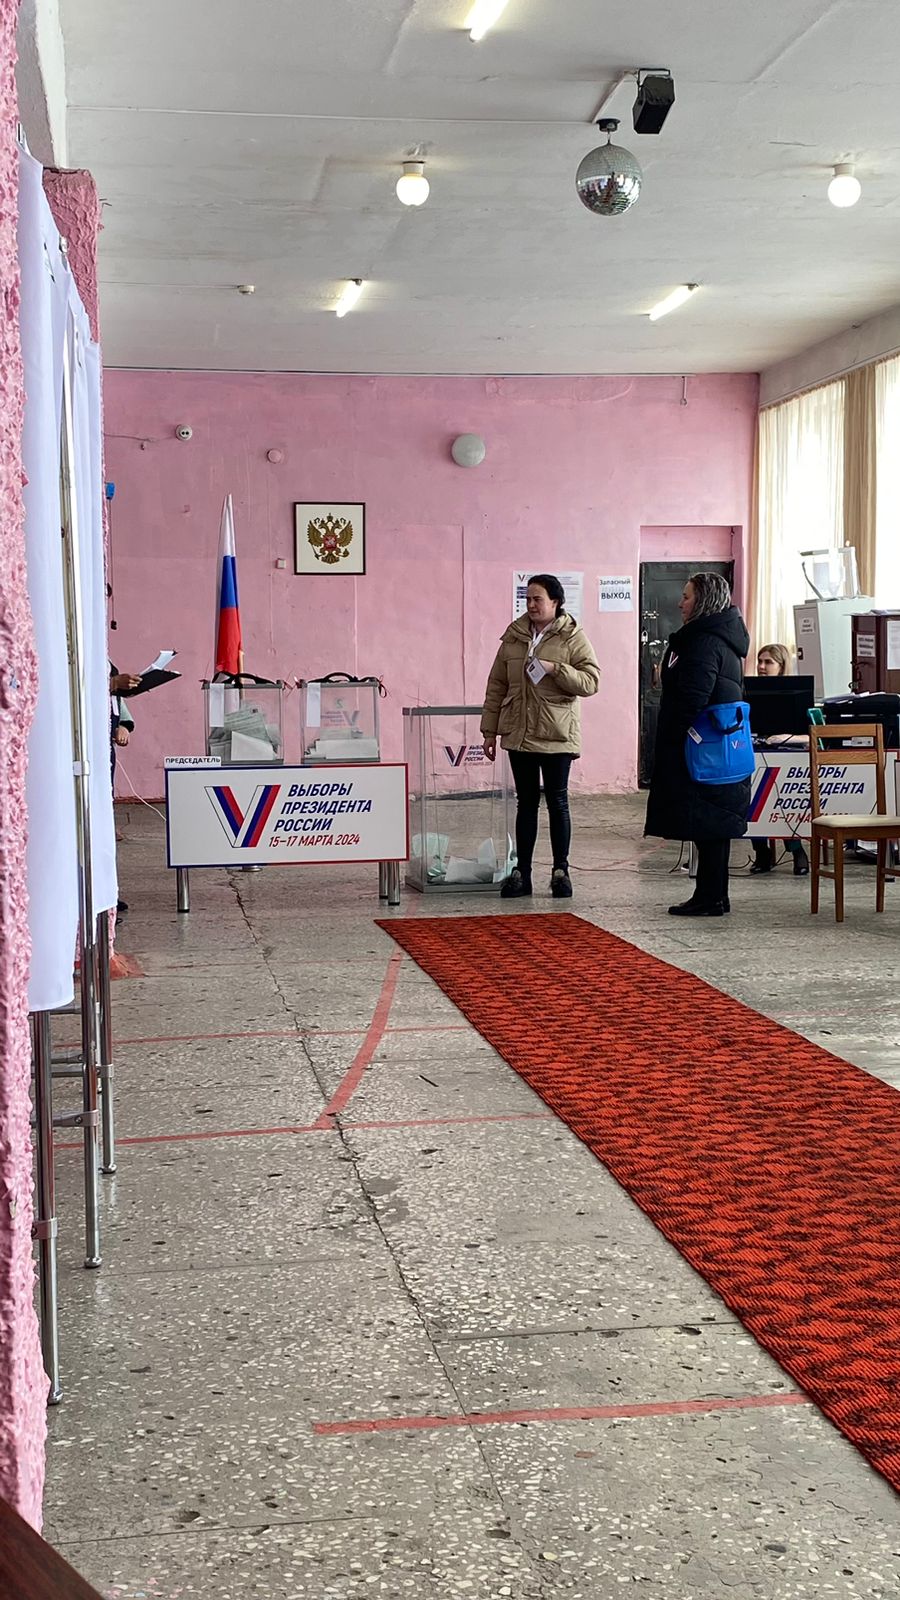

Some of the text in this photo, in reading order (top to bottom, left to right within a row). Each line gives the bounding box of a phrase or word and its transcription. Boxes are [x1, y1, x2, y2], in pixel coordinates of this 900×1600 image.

[601, 592, 630, 600] ВЫХОД
[787, 766, 847, 778] ВЫОРЫ
[288, 783, 353, 797] ВЫБОРЫ
[280, 800, 372, 815] ПРЕЗИДЕНТА
[773, 798, 828, 809] РОССИ
[274, 818, 333, 832] РОССИИ
[298, 835, 333, 846] МАРТА
[335, 834, 360, 845] 2024
